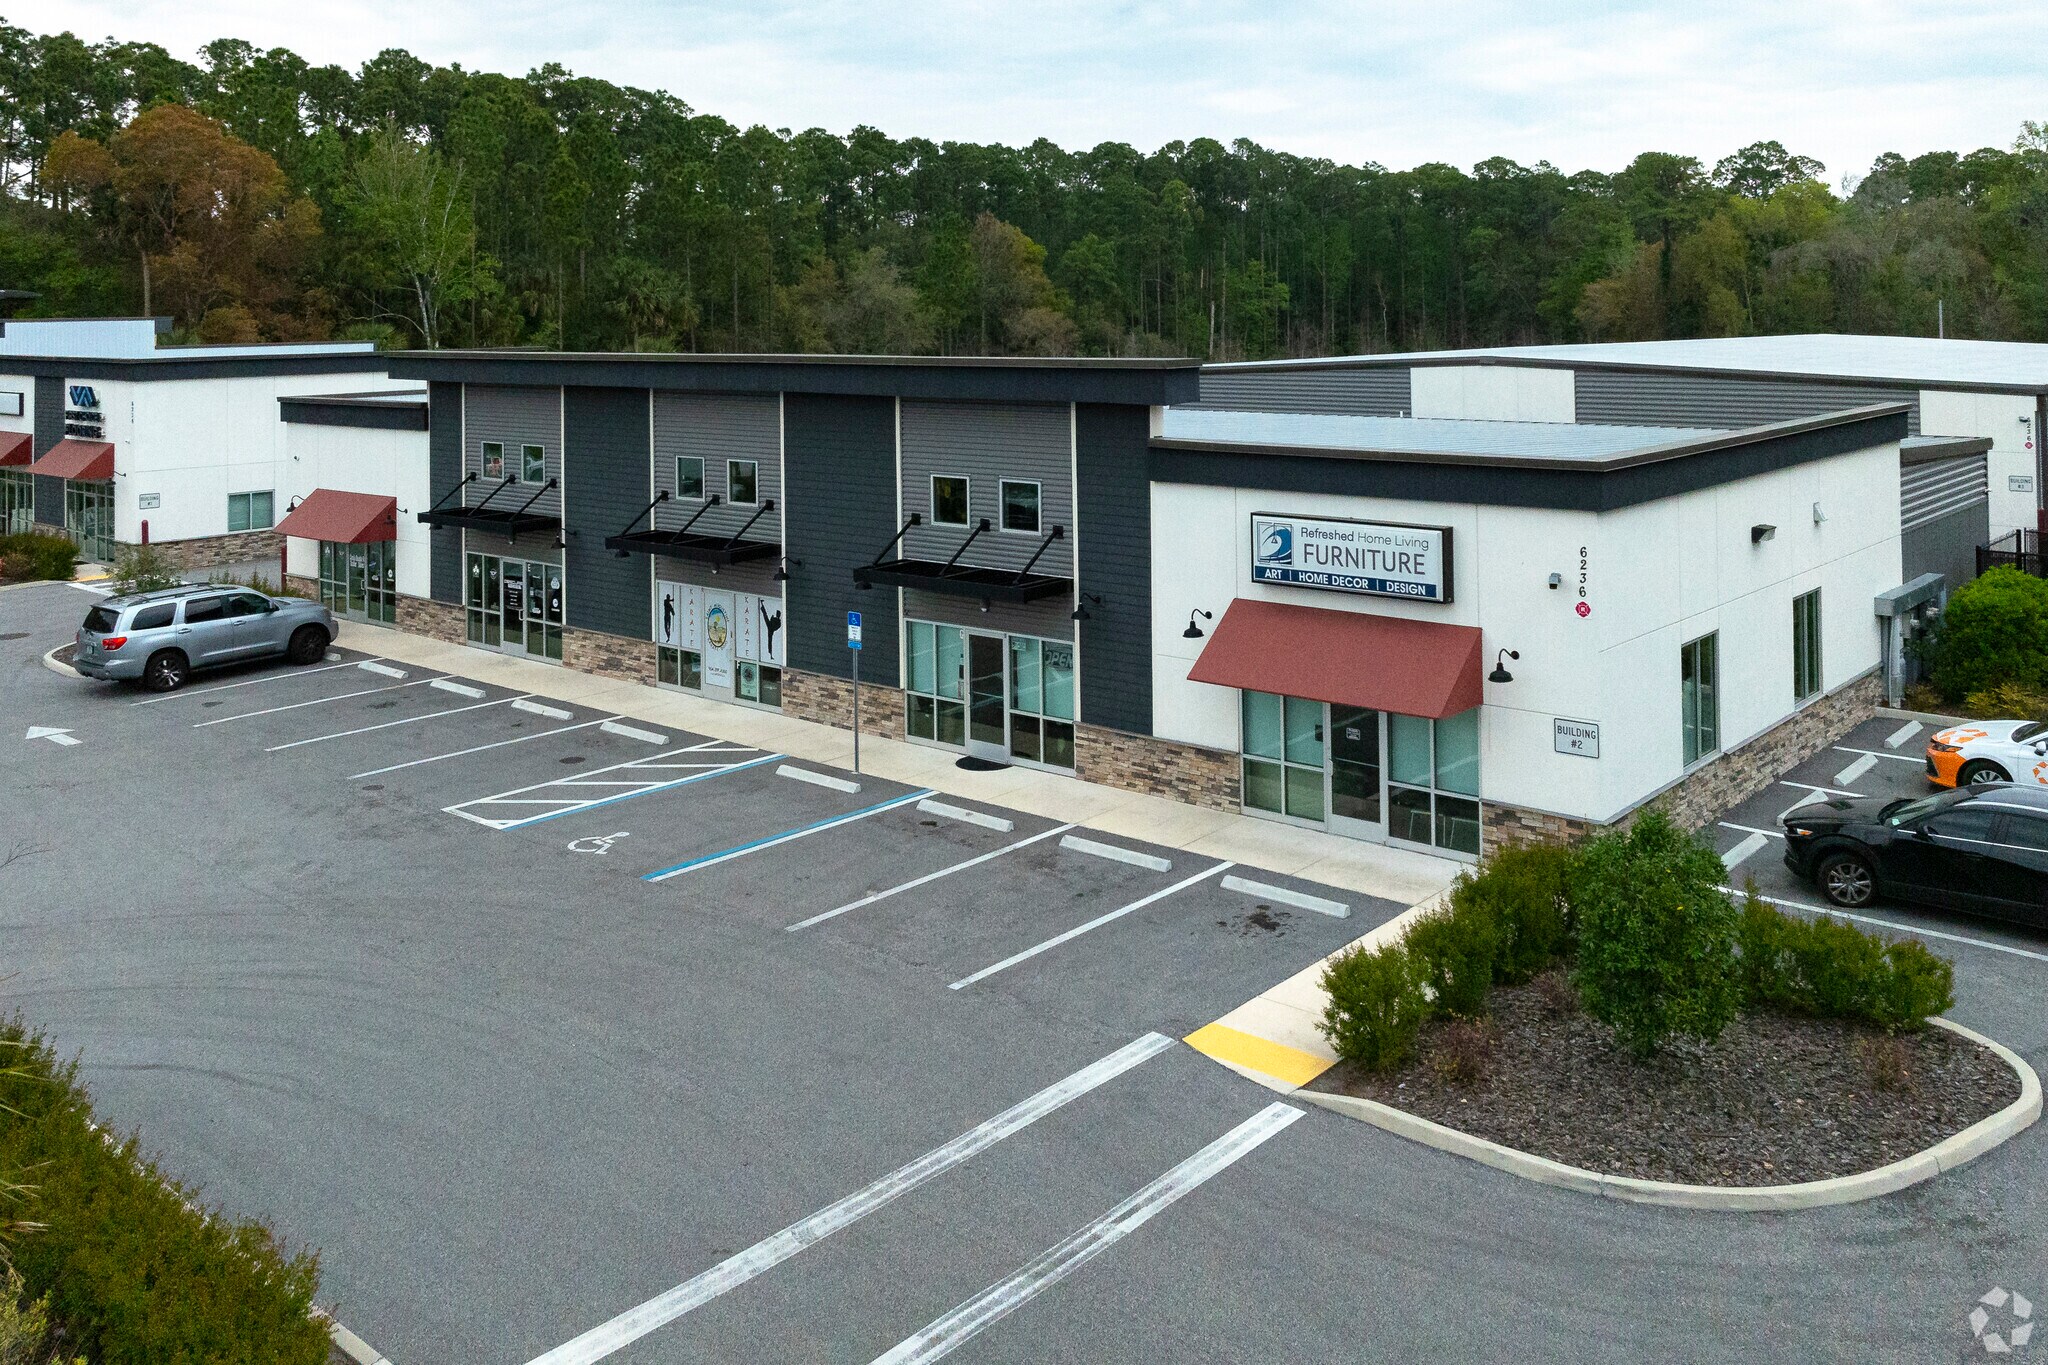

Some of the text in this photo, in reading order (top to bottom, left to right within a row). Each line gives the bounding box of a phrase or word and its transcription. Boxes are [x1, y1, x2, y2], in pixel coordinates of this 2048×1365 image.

[1301, 527, 1429, 551] Refreshed Home Living
[1303, 543, 1426, 575] FURNITURE
[1265, 568, 1426, 596] ART HOME DECOR DESIGN
[1579, 546, 1587, 597] 6236
[1044, 650, 1073, 668] OPEN
[1557, 725, 1597, 740] BUILDING
[1571, 739, 1583, 750] #2
